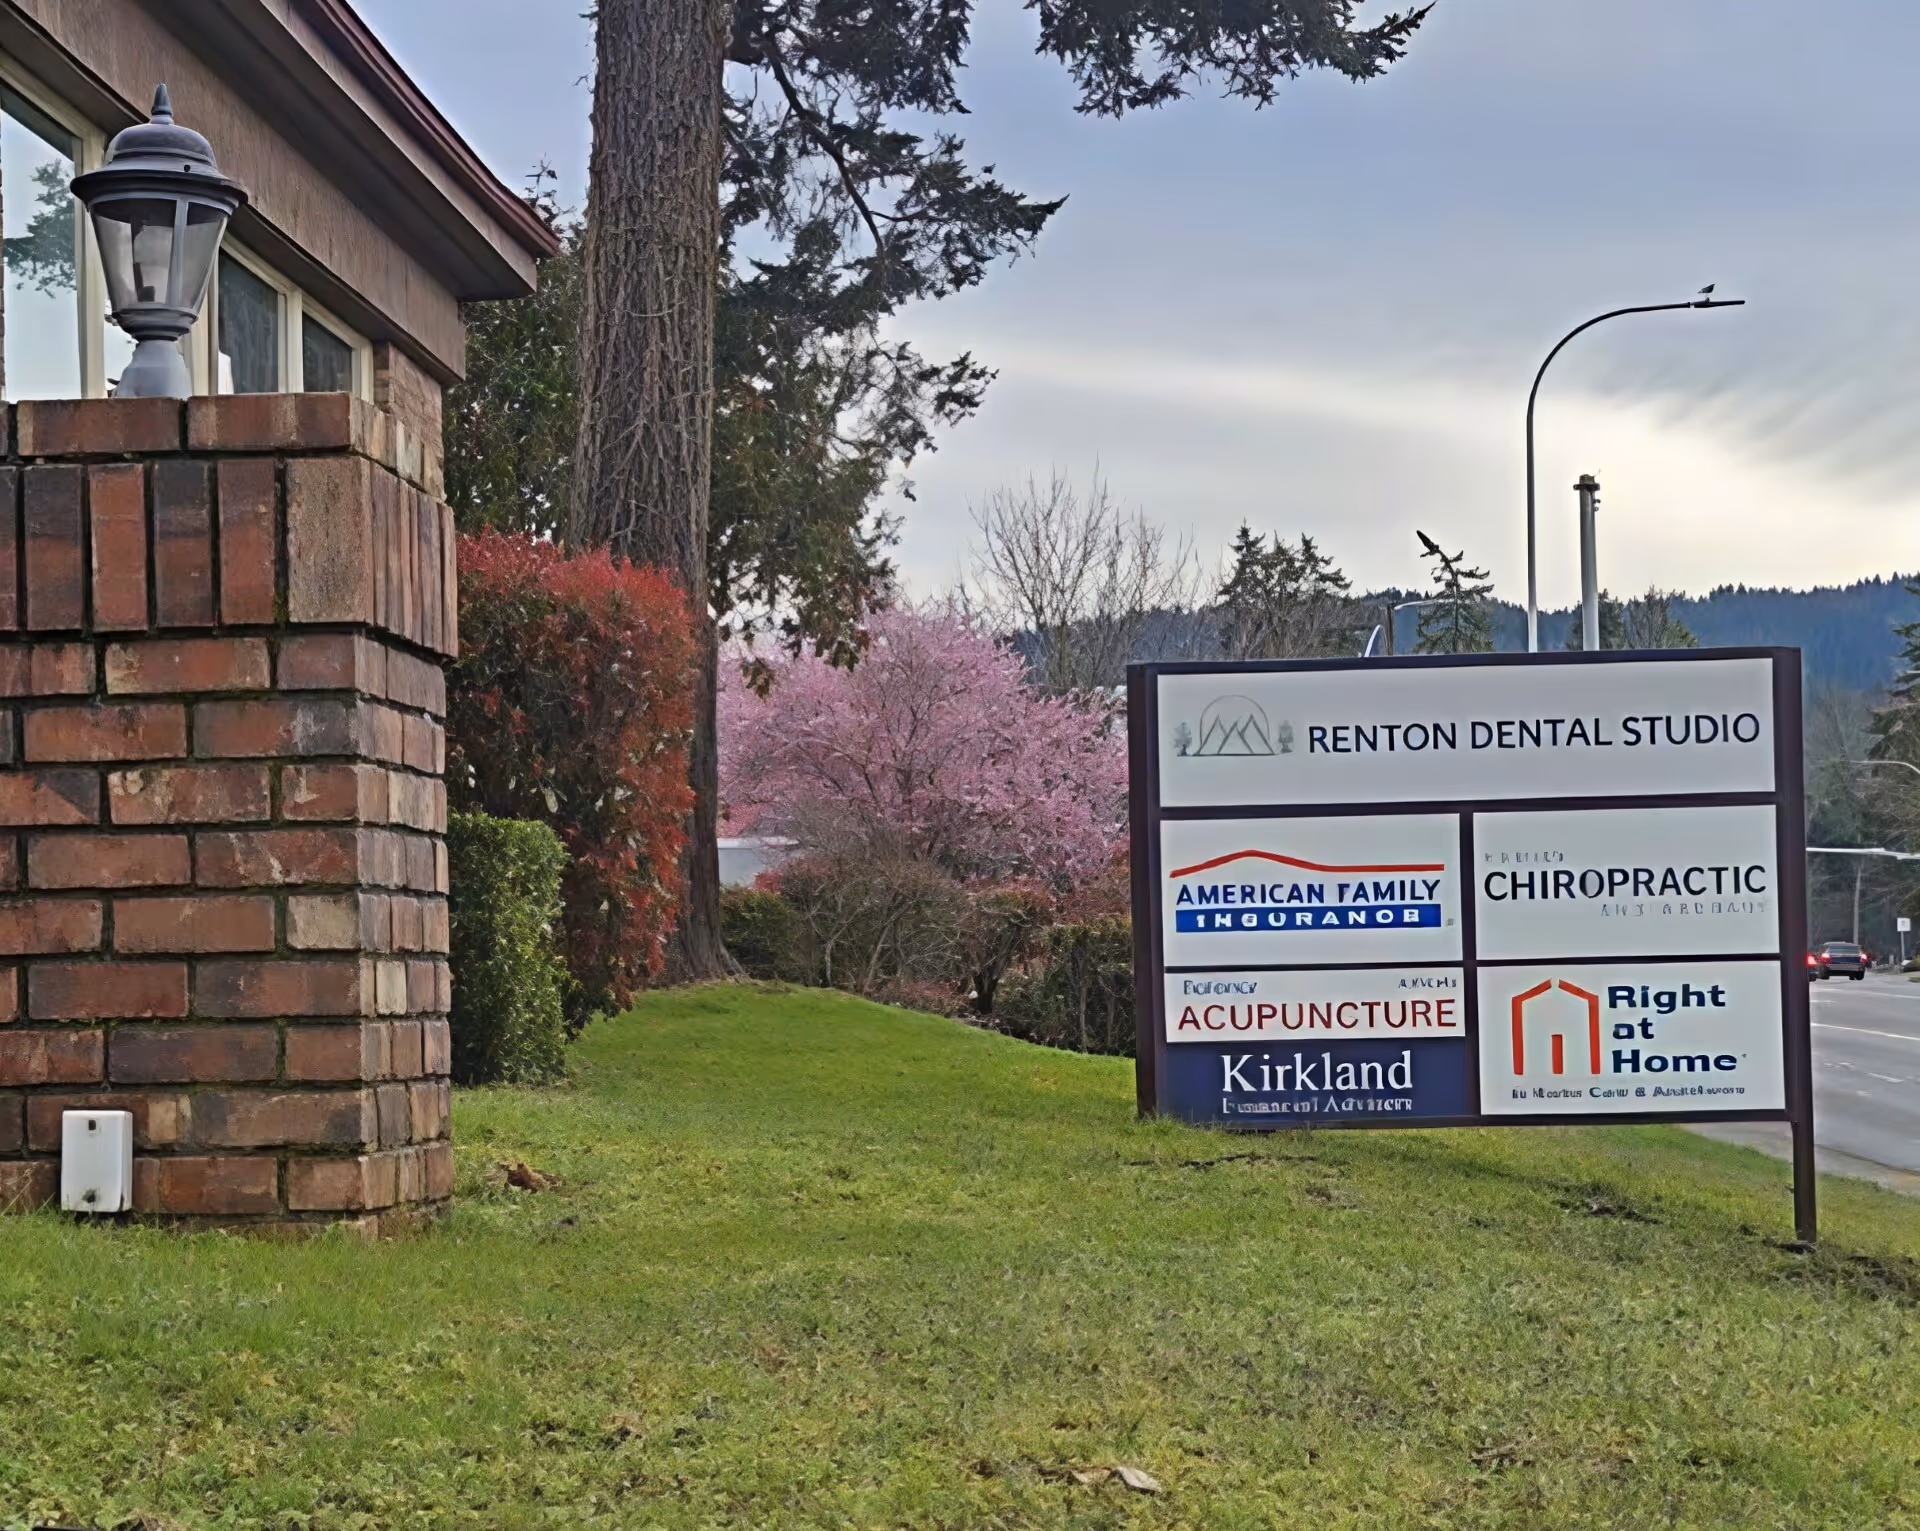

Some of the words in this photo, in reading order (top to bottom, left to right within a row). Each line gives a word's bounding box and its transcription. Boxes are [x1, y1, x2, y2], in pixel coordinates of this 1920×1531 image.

[1308, 723, 1457, 754] RENTON
[1470, 718, 1613, 750] DENTAL
[1621, 713, 1761, 747] STUDIO
[1176, 883, 1325, 906] AMERICAN
[1337, 879, 1441, 902] FAMILY
[1484, 864, 1767, 901] CHIROPRACTIC
[1178, 998, 1457, 1031] ACUPUNCTURE
[1607, 983, 1726, 1015] Right
[1612, 1017, 1655, 1040] at
[1220, 1049, 1413, 1093] Kirkland
[1611, 1049, 1738, 1074] Home
